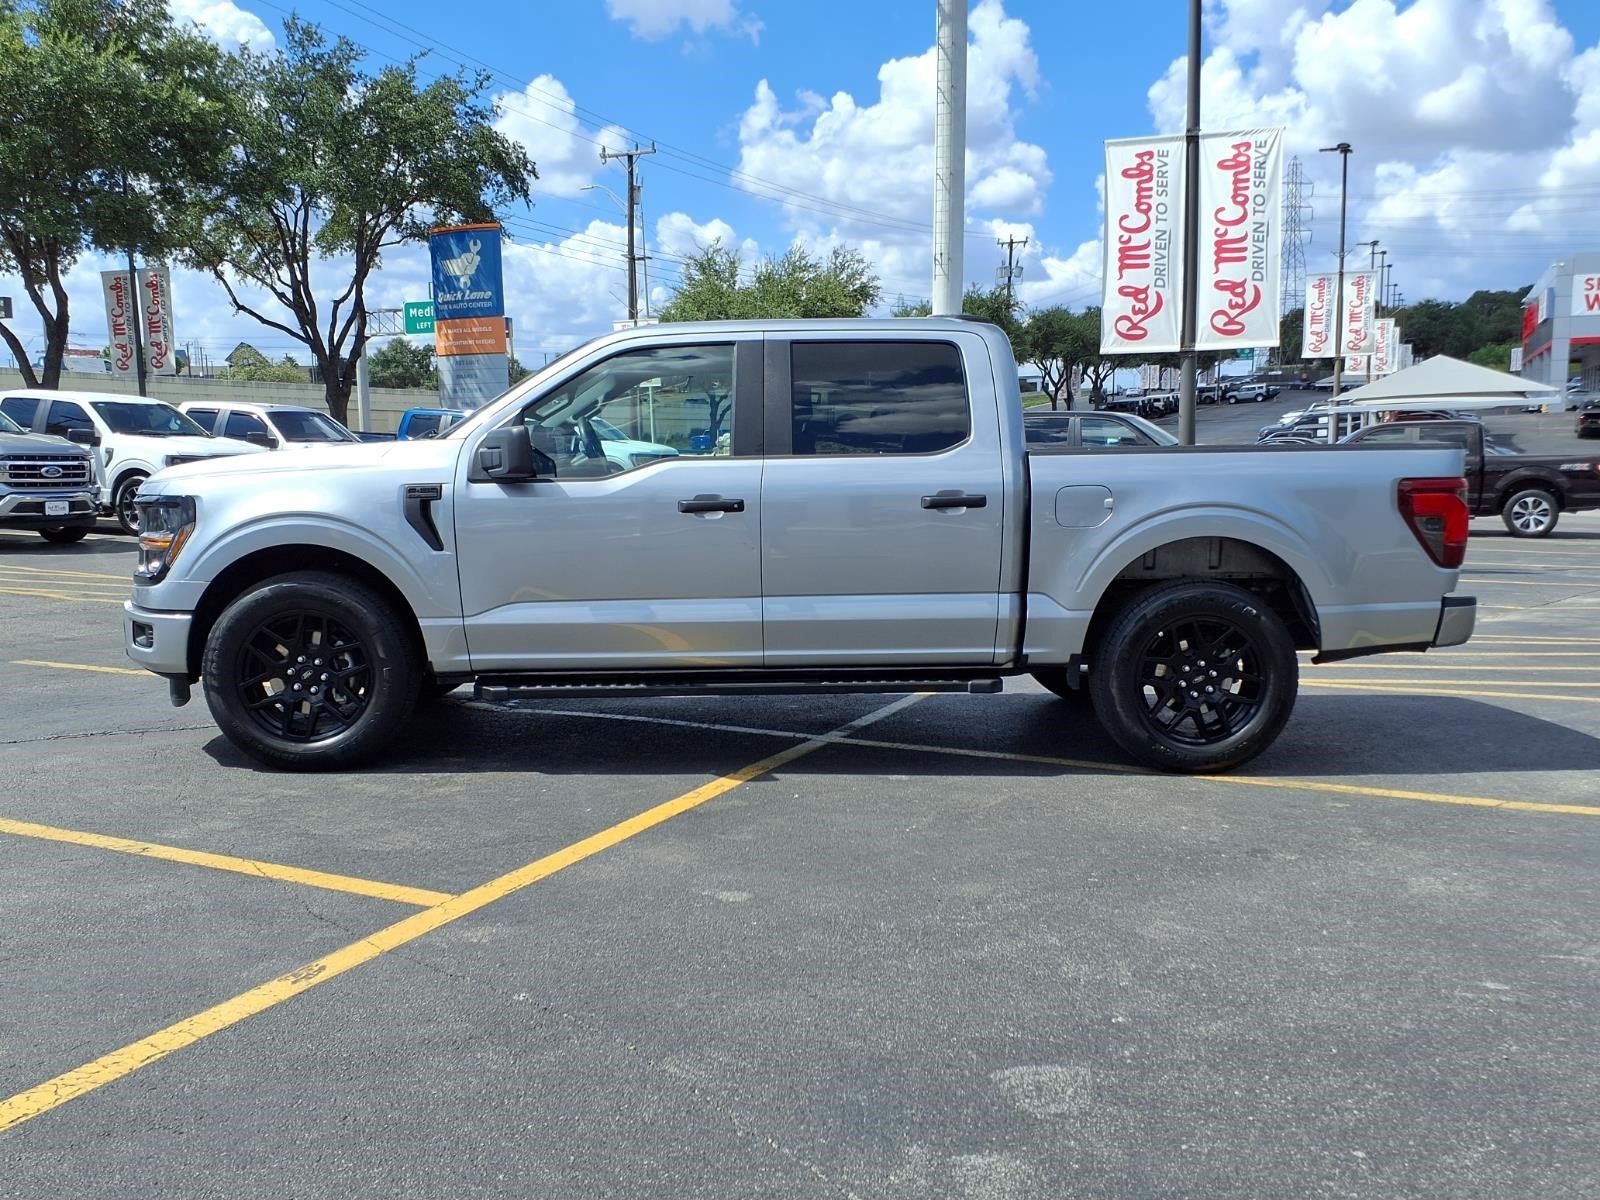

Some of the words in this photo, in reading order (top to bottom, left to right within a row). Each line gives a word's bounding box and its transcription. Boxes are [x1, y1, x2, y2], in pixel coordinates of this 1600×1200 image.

[1156, 149, 1169, 198] SERVE
[1254, 139, 1268, 189] SERVE
[1117, 150, 1155, 280] McCombs
[1155, 203, 1168, 224] TO
[1213, 141, 1252, 274] McCombs
[1253, 194, 1266, 216] TO
[1154, 229, 1167, 289] DRIVEN
[1252, 221, 1265, 282] DRIVEN
[122, 276, 130, 302] SERVE
[438, 291, 462, 303] Quick
[464, 290, 492, 300] Lane
[1310, 277, 1326, 328] McCombs
[1349, 275, 1365, 326] McCombs
[109, 276, 127, 339] McCombs
[124, 303, 131, 314] TO
[145, 273, 161, 338] McCombs
[160, 300, 166, 311] TO
[468, 301, 493, 309] CENTER
[1114, 284, 1164, 341] Red
[1209, 278, 1262, 336] Red
[126, 317, 134, 346] DRIVEN
[161, 313, 169, 343] DRIVEN
[416, 321, 431, 329] LEFT
[1324, 309, 1332, 333] DRIVEN
[1308, 330, 1328, 353] Red
[1347, 328, 1367, 351] Red
[115, 343, 134, 371] Red
[150, 341, 168, 369] Red
